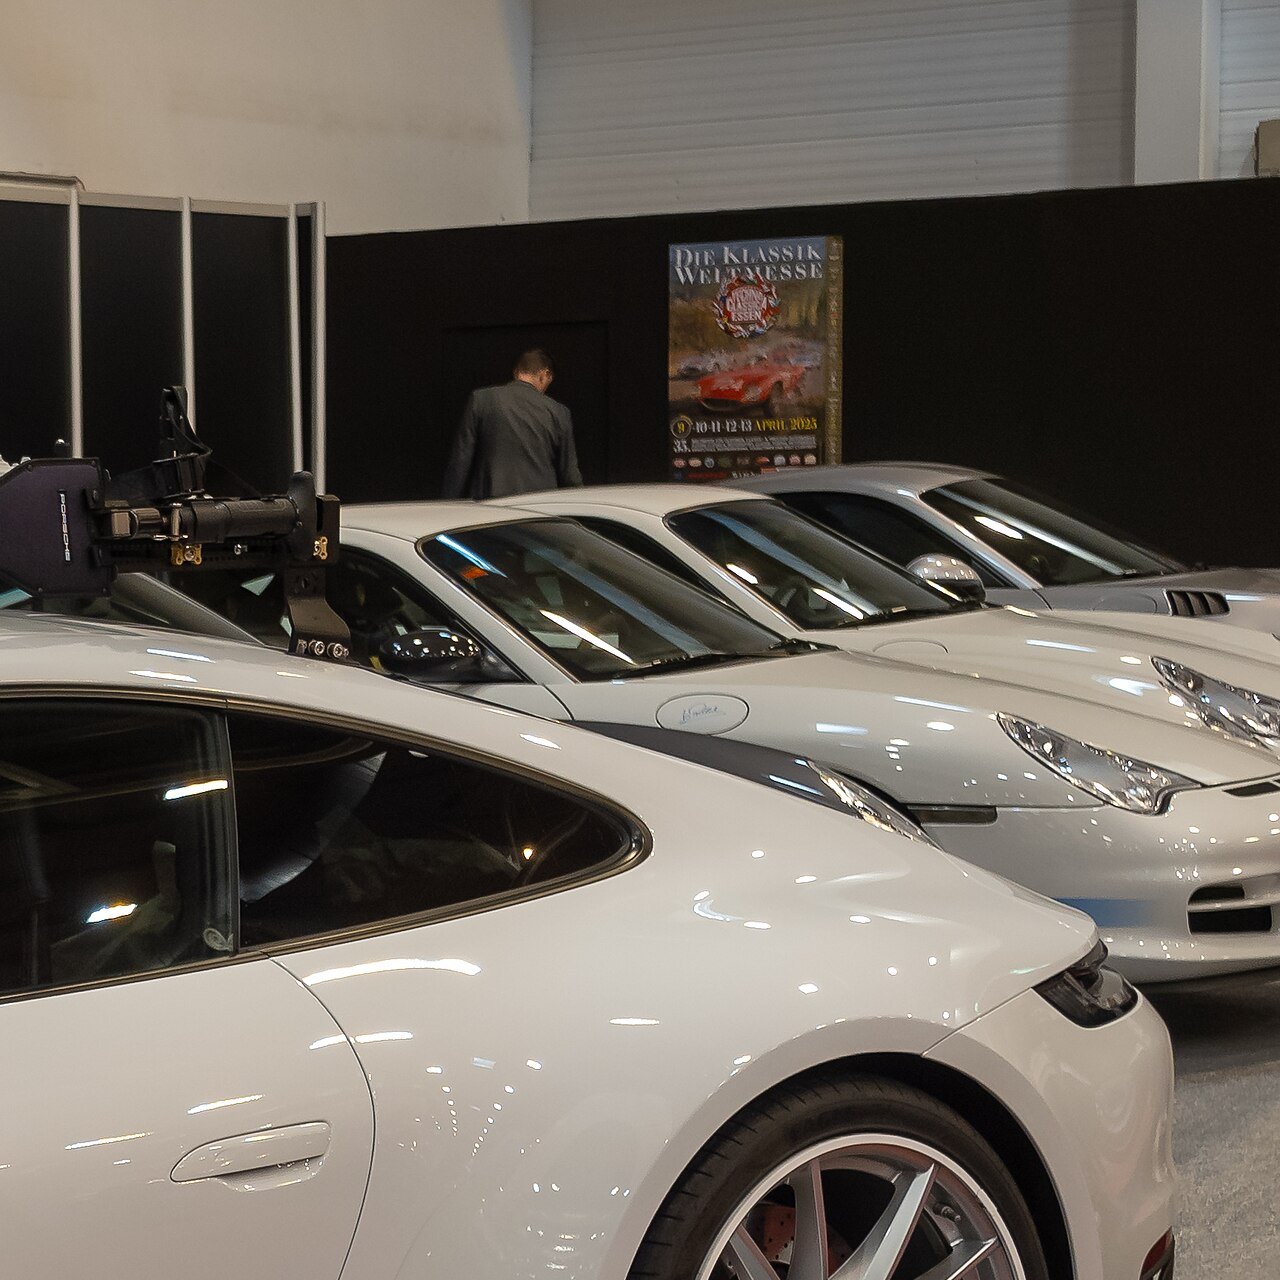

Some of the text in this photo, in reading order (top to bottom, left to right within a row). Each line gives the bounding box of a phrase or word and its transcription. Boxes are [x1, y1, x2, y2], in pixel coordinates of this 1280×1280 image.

[675, 245, 822, 267] DIE KLASSIK
[60, 493, 71, 561] PORSCHE
